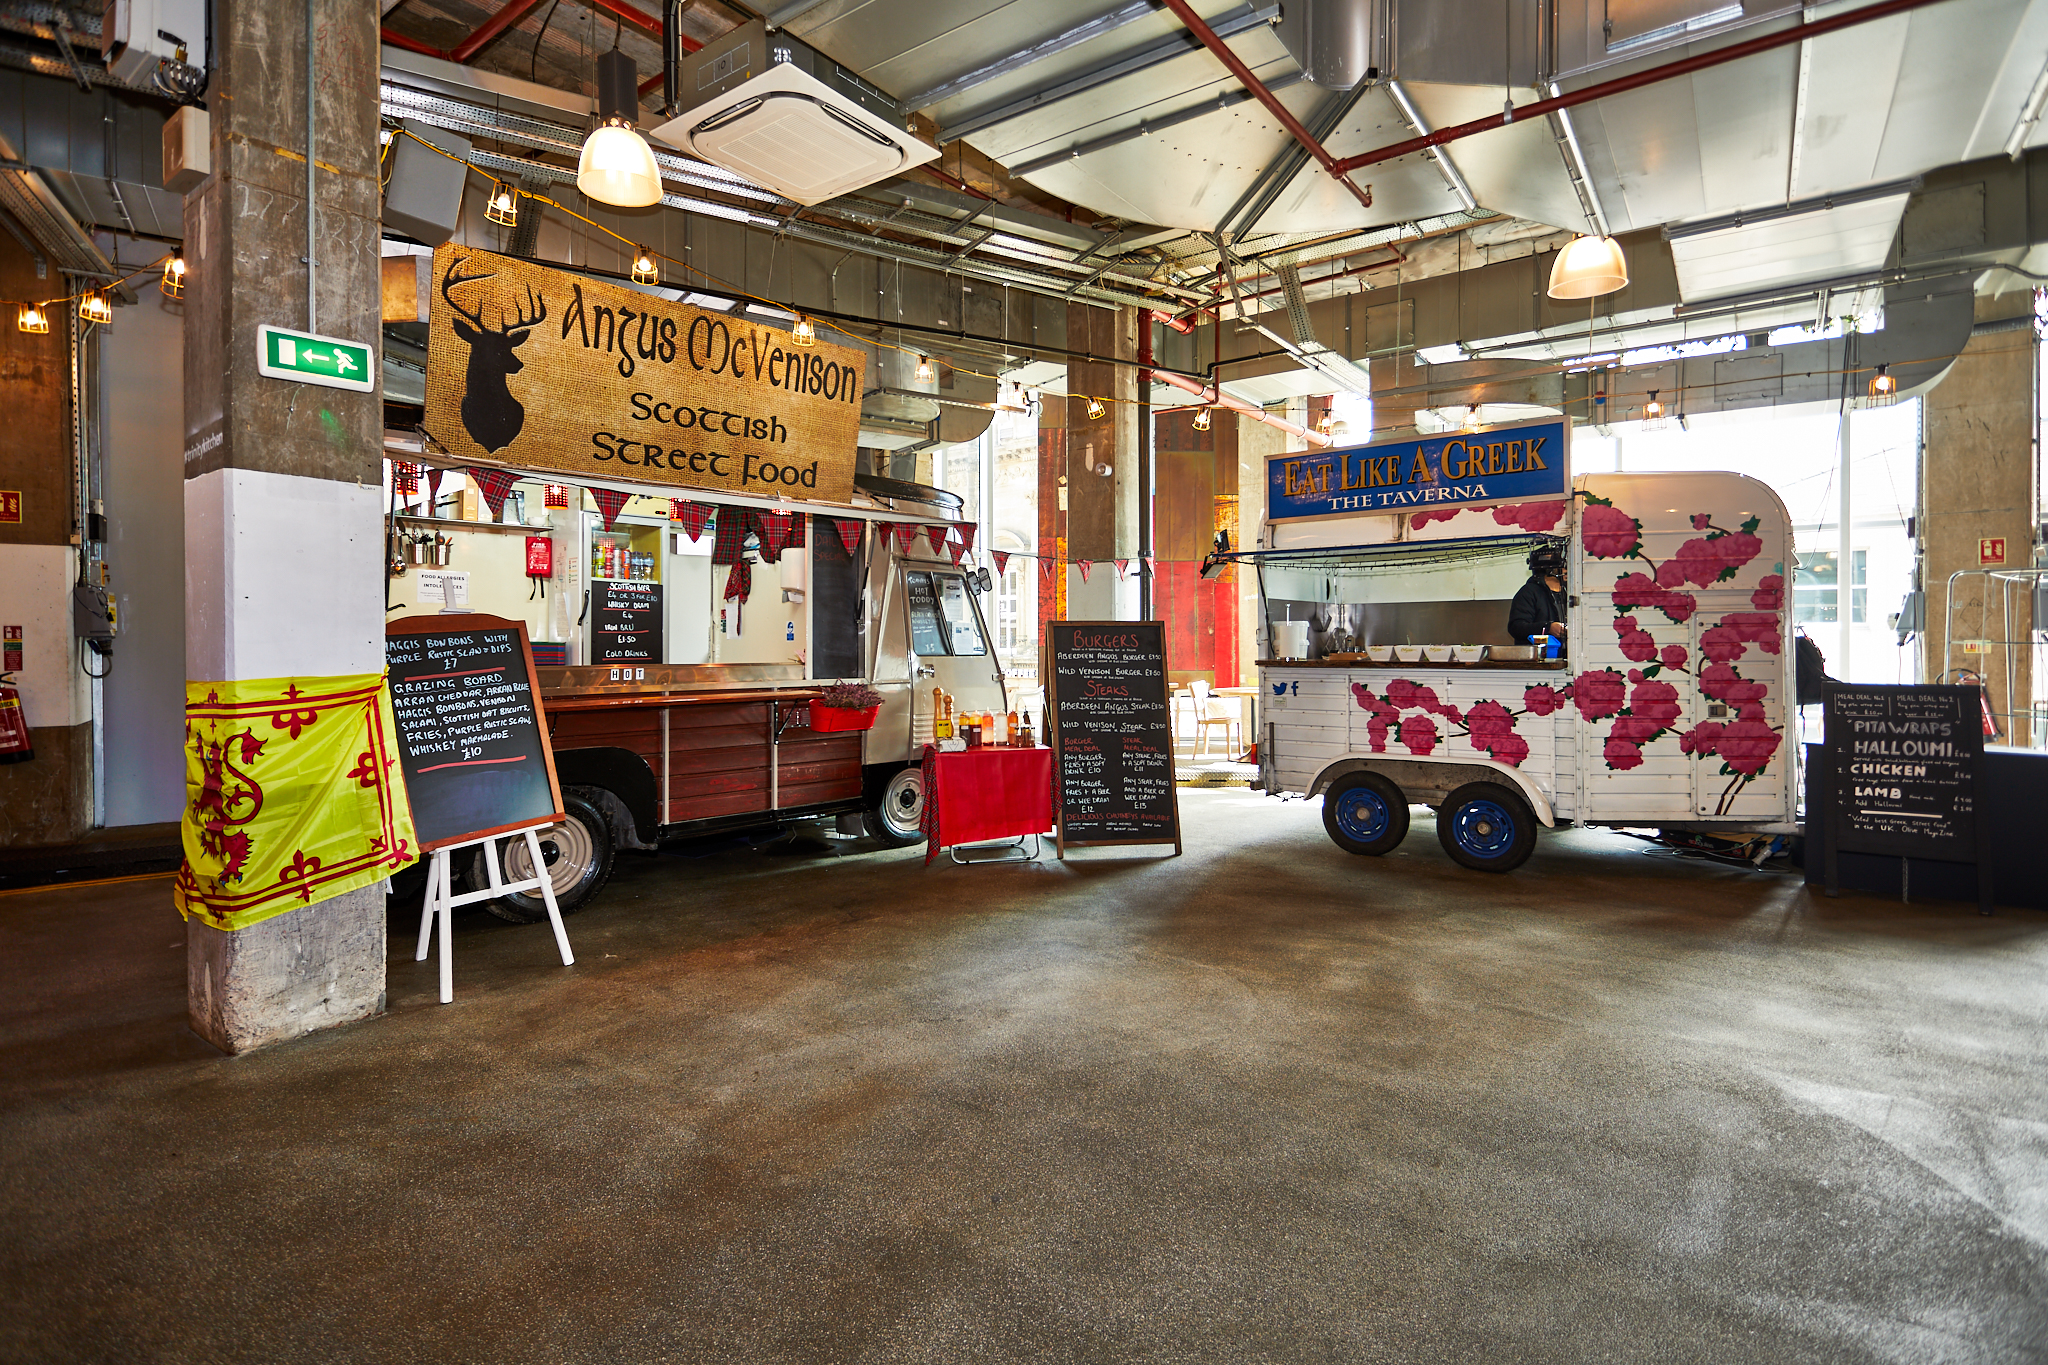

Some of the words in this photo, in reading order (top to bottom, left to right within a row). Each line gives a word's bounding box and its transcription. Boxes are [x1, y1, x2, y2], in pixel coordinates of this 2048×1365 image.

[562, 283, 676, 378] Angus
[688, 315, 856, 404] McVenison
[631, 392, 787, 444] Scottish
[592, 432, 732, 478] Street
[742, 454, 818, 488] Food
[1282, 461, 1332, 496] EAT
[1338, 454, 1402, 490] LIKE
[1406, 446, 1433, 486] A
[1441, 437, 1548, 480] GREEK
[1328, 493, 1372, 510] THE
[1378, 484, 1490, 506] TAVERNA
[484, 634, 508, 643] WITH
[1074, 630, 1139, 648] BURGERS
[490, 644, 512, 653] DIPS
[1057, 652, 1093, 660] ABERDEEN
[444, 658, 457, 670] £7
[612, 669, 642, 679] HOT
[1079, 666, 1110, 675] VENISON
[1115, 668, 1142, 676] BURGER
[394, 680, 455, 694] GRAZING
[464, 673, 502, 686] BOARD
[1084, 680, 1128, 696] STEAKS
[394, 696, 434, 708] ARRAN
[1061, 701, 1100, 711] ABERDEEN
[1105, 702, 1128, 711] ANGUS
[398, 708, 432, 719] HAGGIS
[442, 712, 480, 724] SCOTTISH
[482, 709, 497, 718] OAT
[448, 724, 482, 737] PURPLE
[484, 719, 508, 729] RUSTIC
[1120, 722, 1146, 730] STEAK
[409, 740, 456, 757] WHISKEY
[1854, 740, 1952, 757] HALLOUMI
[1850, 764, 1926, 776] CHICKEN
[1124, 777, 1136, 785] ANY
[1854, 787, 1901, 799] LAMB
[1066, 813, 1104, 821] DELICIOUS
[1901, 826, 1918, 834] Olive
